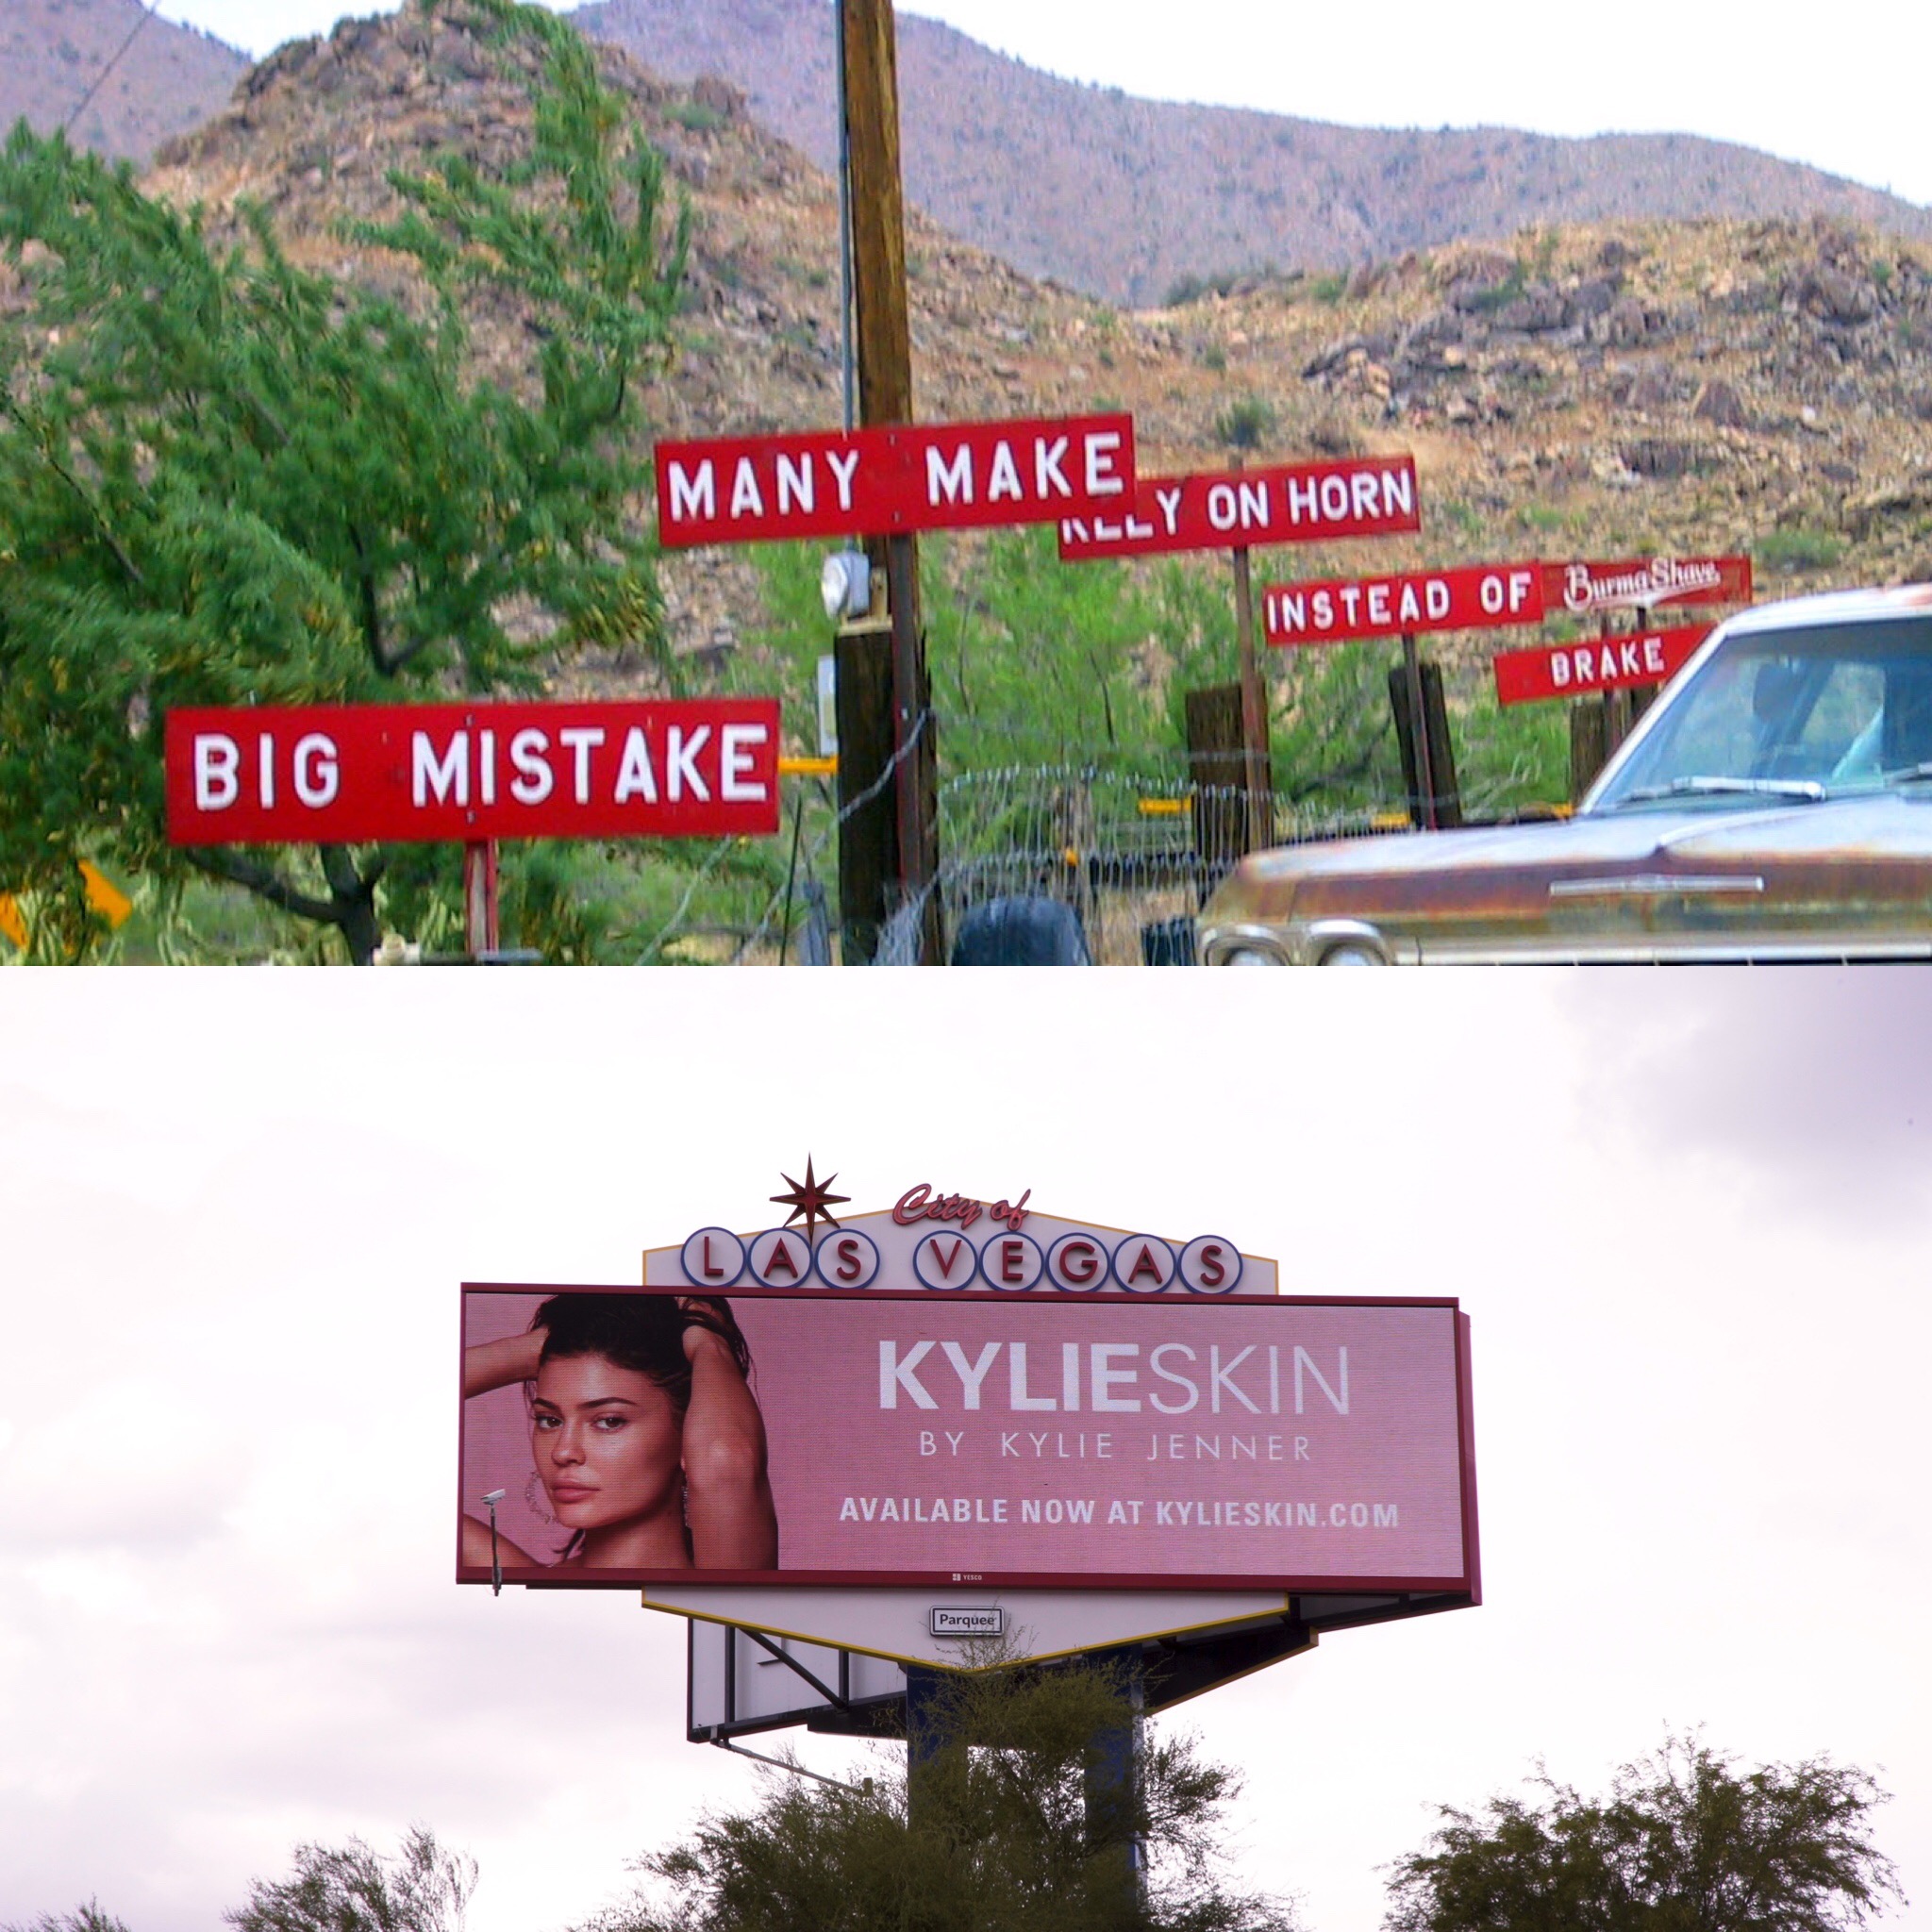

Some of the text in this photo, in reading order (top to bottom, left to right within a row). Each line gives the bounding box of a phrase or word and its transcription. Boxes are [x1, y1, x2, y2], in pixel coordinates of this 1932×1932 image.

[668, 431, 1124, 522] MANY MAKE
[1208, 480, 1270, 531] ON
[1288, 469, 1412, 525] HORN
[1268, 573, 1532, 633] INSTEAD OF
[1551, 637, 1664, 687] BRAKE
[194, 724, 768, 811] BIG MISTAKE
[891, 1183, 1032, 1232] City of
[702, 1235, 1228, 1286] LAS VEGAS
[879, 1340, 1351, 1415] KYLIESKIN
[920, 1430, 1312, 1462] BY KYLIE JENNER
[839, 1496, 1400, 1528] AVAILABLE NOW AT KYLIESKIN.COM
[940, 1613, 995, 1628] Parquee
